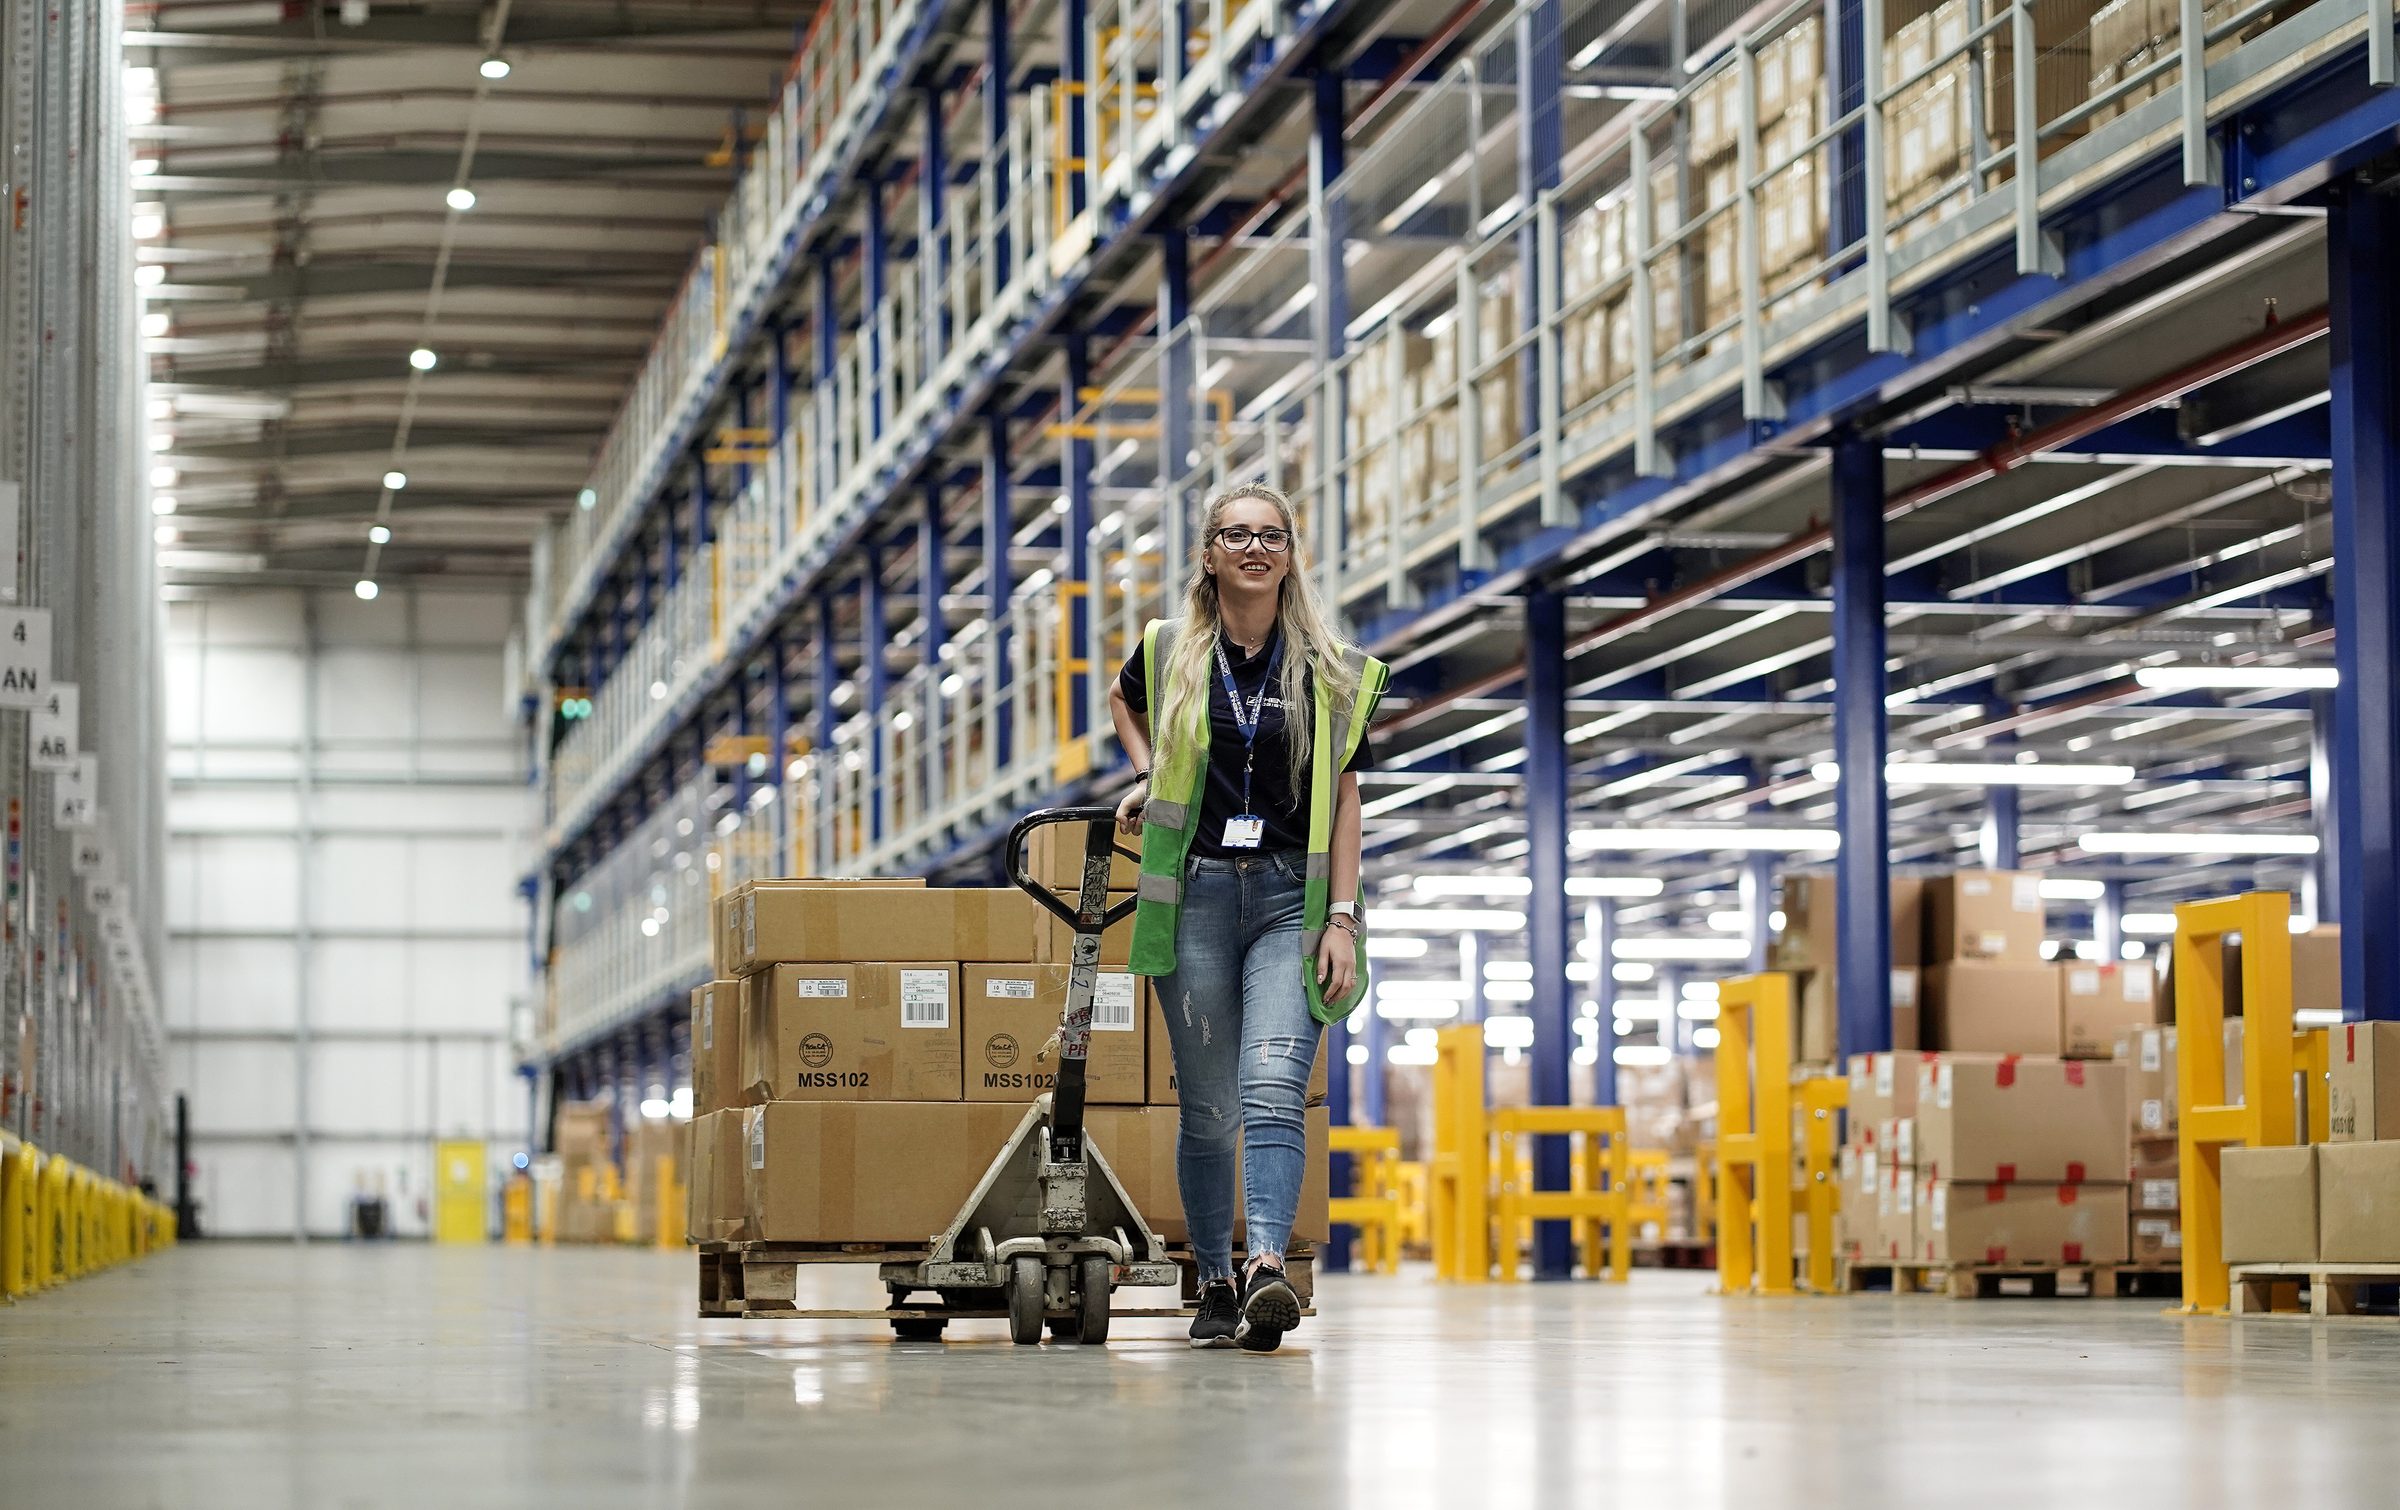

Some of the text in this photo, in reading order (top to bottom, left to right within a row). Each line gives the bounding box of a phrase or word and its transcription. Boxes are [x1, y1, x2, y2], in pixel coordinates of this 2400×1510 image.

[13, 621, 26, 642] 4
[2, 666, 37, 691] AN
[798, 1072, 869, 1088] MSS102
[984, 1072, 1054, 1088] MSS102
